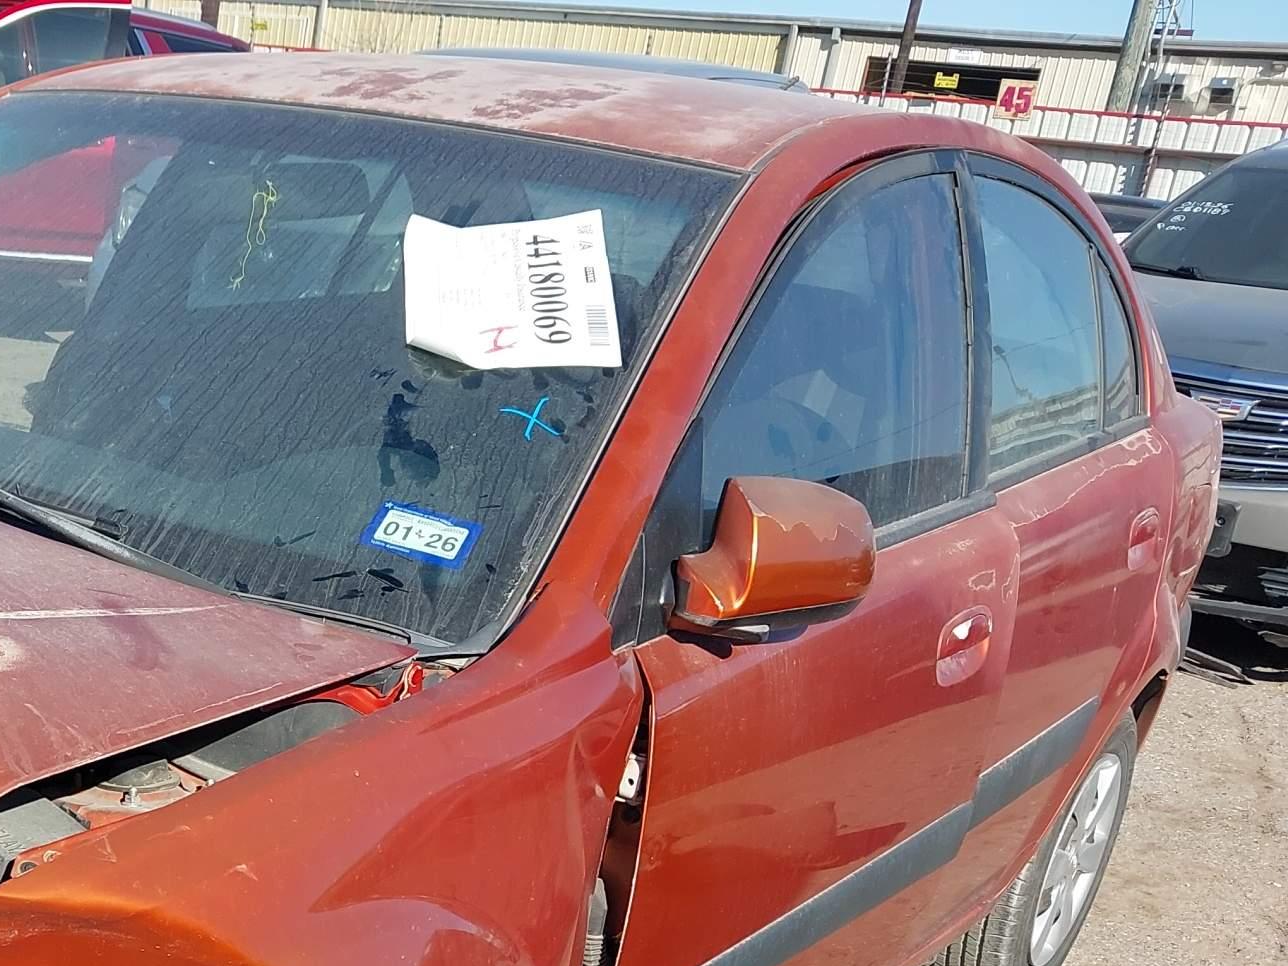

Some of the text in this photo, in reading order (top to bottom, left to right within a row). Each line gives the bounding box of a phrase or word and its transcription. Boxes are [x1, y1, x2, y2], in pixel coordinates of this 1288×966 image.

[999, 86, 1033, 113] 45
[525, 234, 572, 345] 44180069
[424, 533, 459, 552] 26
